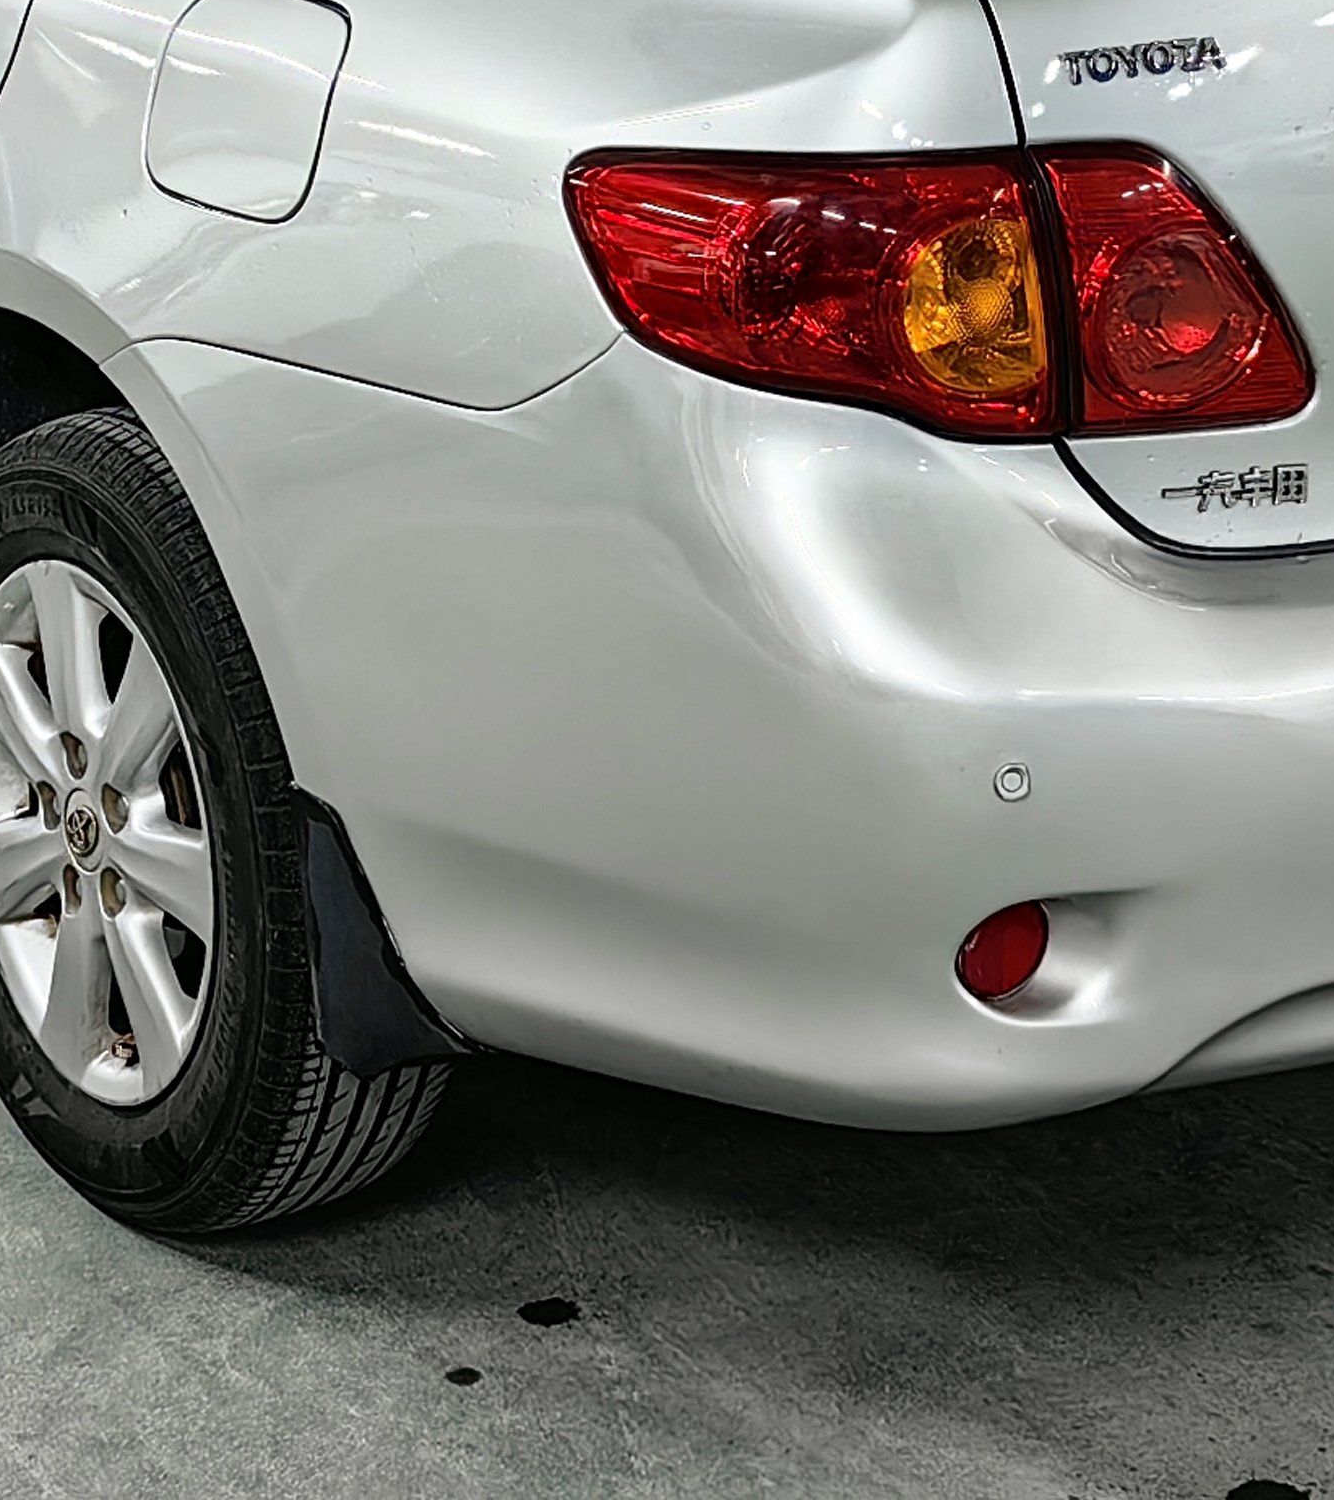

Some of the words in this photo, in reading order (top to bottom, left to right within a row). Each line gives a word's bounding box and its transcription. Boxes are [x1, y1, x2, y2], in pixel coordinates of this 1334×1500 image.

[1058, 37, 1227, 86] TOYOTA
[1161, 463, 1309, 513] 一汽丰田
